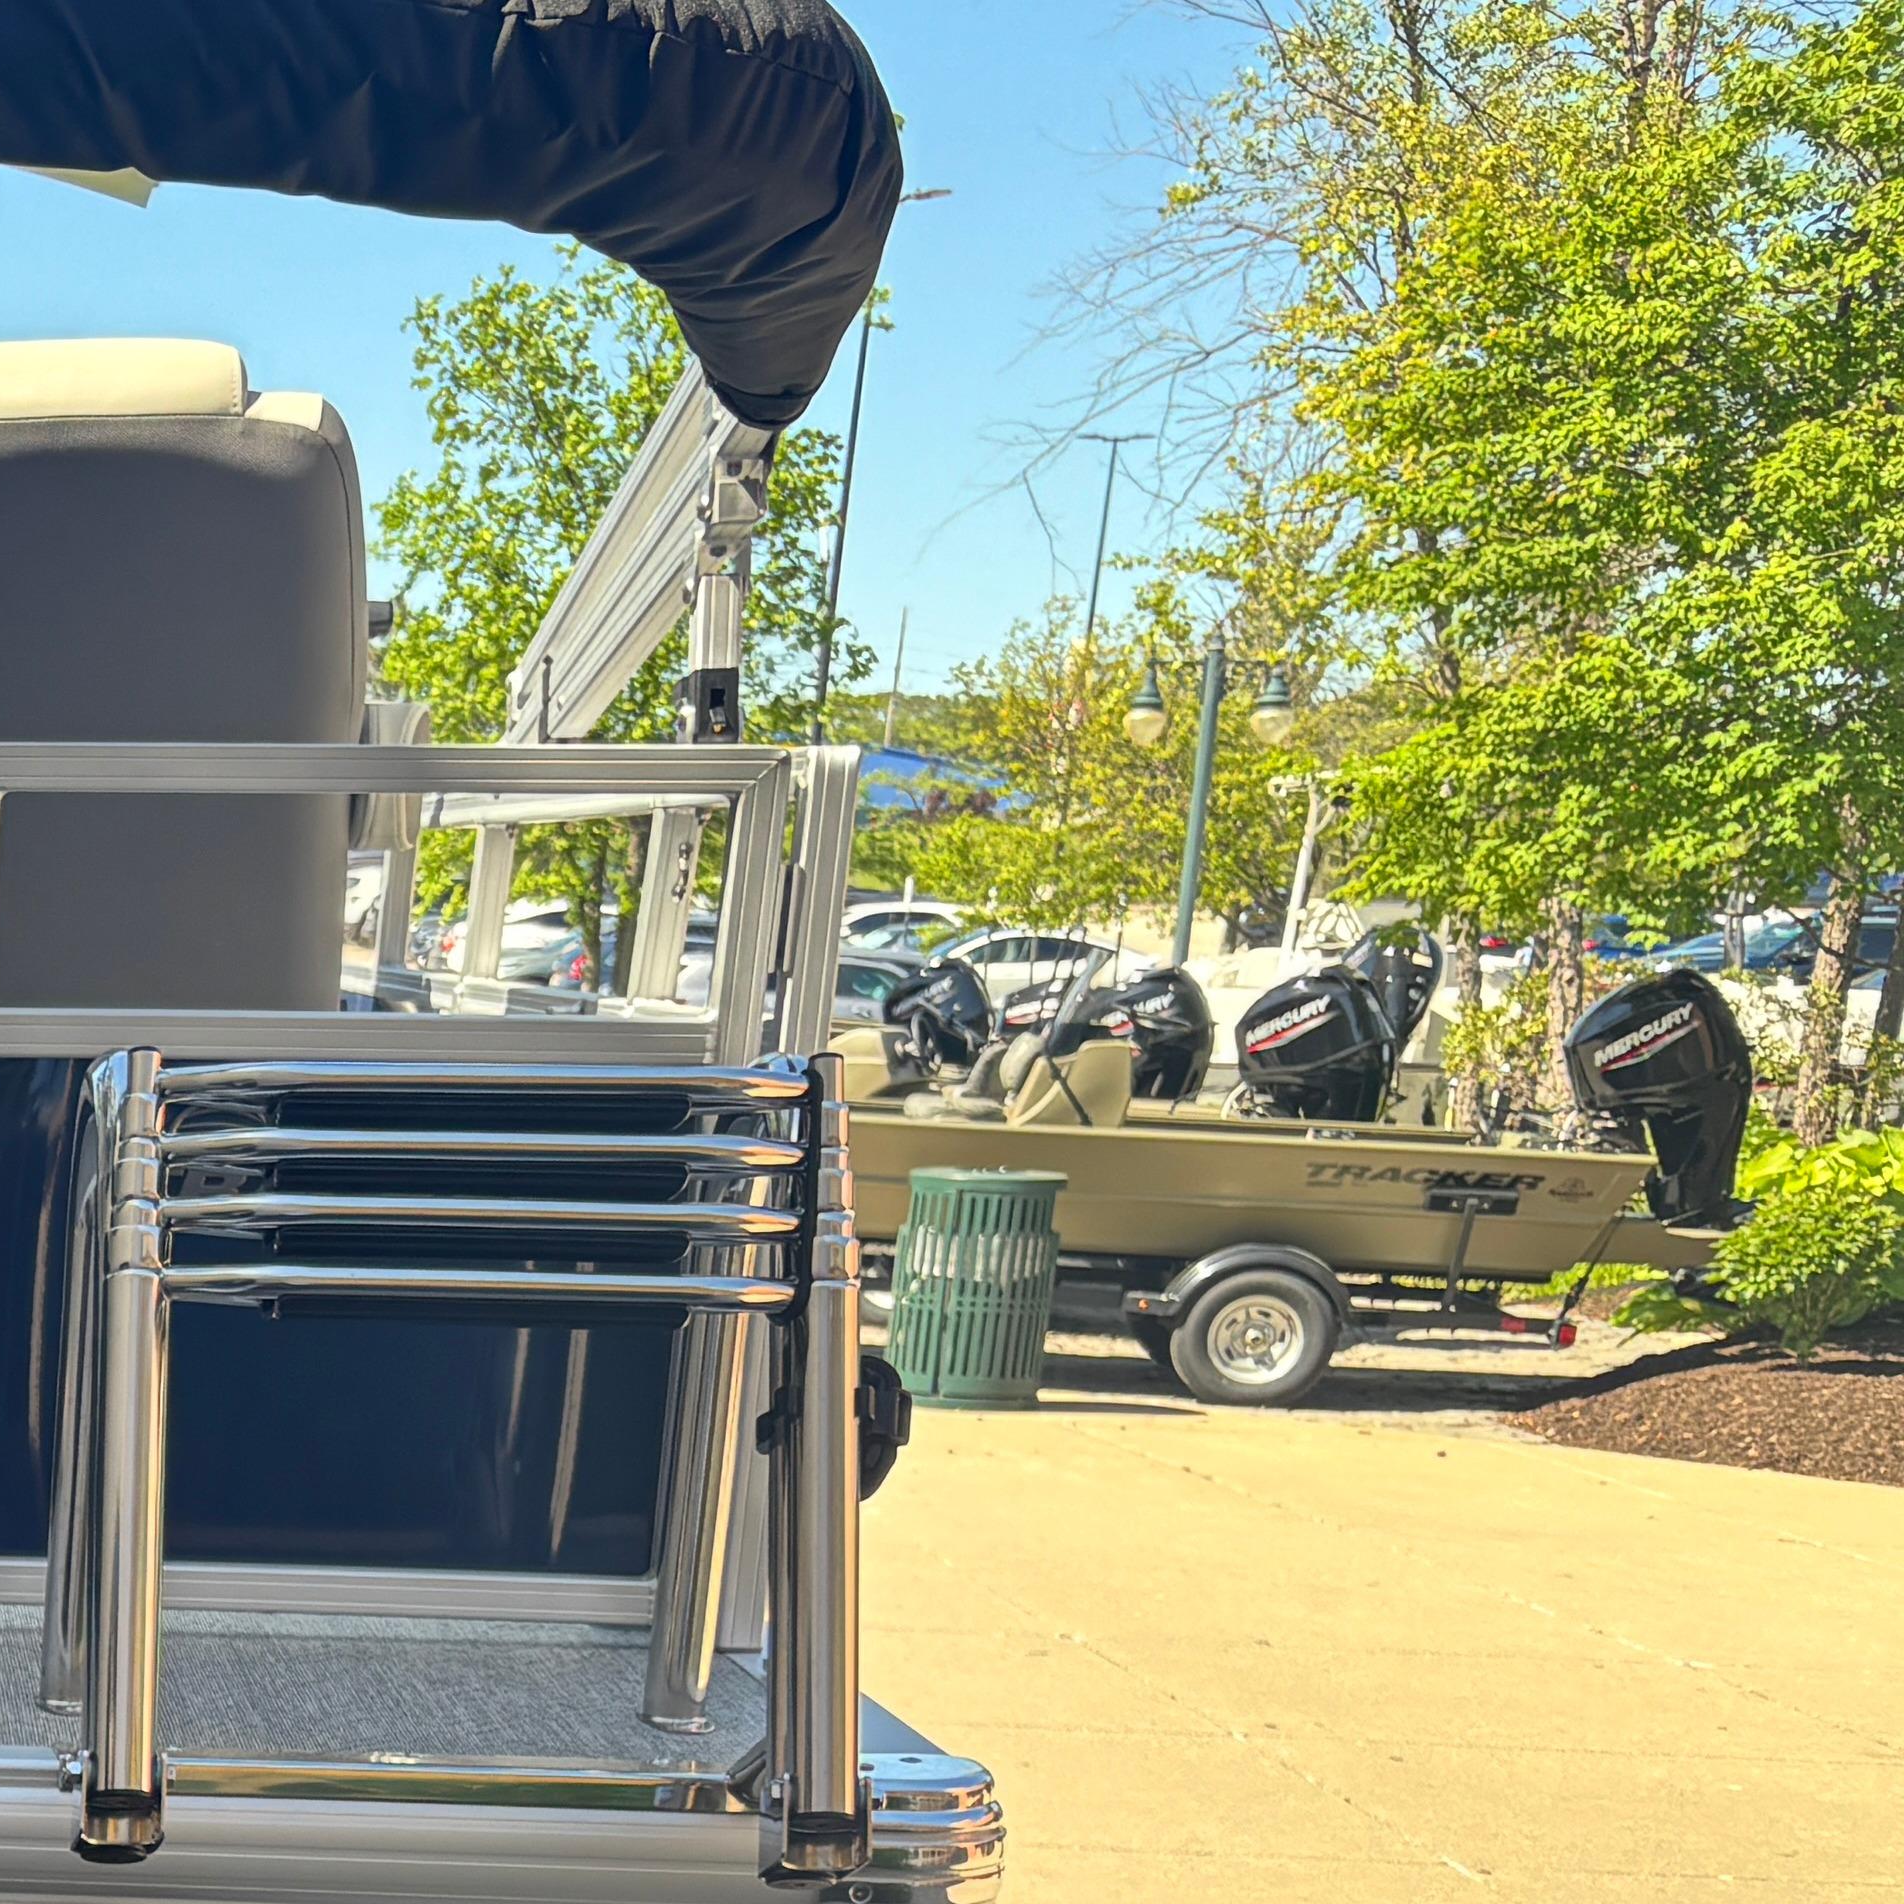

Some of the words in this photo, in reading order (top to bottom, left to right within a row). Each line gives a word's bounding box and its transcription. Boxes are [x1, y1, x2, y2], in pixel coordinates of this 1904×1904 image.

[1245, 994, 1332, 1047] MERCURY
[1594, 1001, 1694, 1068] MERCURY
[1305, 1161, 1546, 1191] TRACKER
